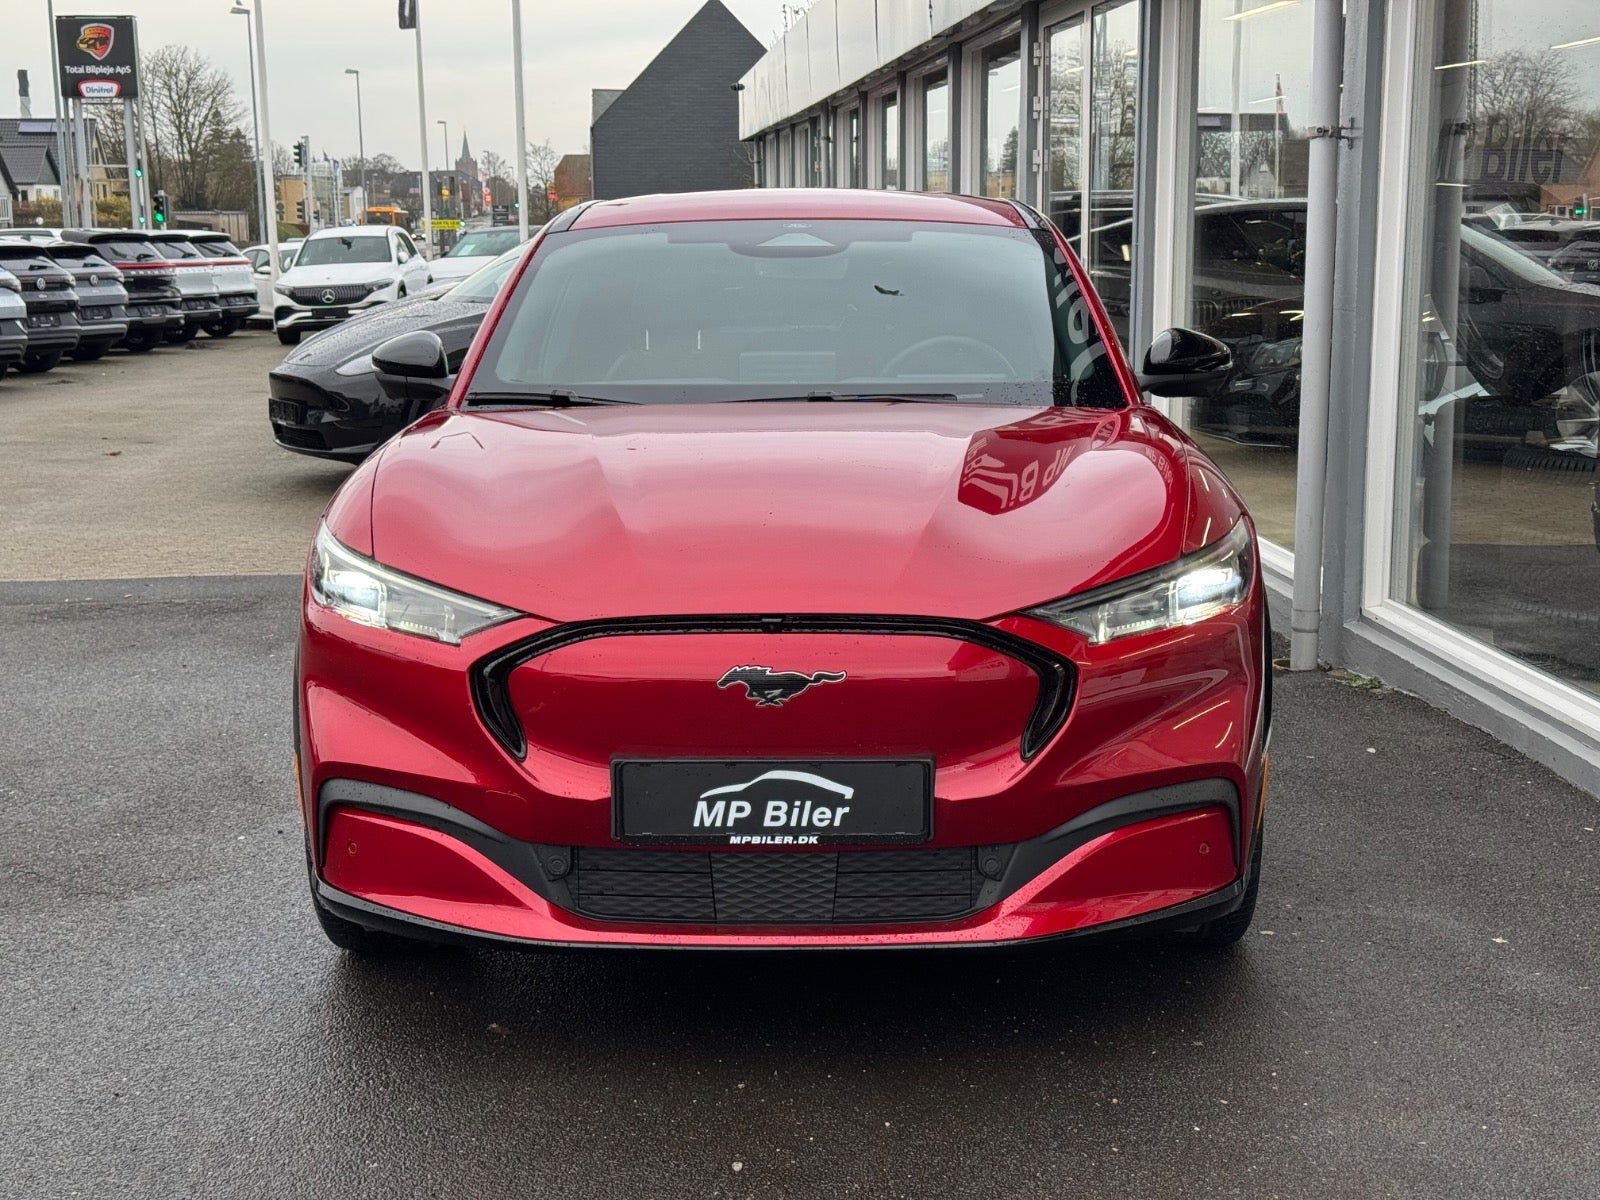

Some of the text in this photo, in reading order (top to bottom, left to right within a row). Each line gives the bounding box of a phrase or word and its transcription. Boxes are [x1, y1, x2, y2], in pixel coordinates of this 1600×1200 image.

[65, 65, 131, 75] Total Bilpleje ApS
[693, 800, 850, 828] MP Biler
[729, 836, 819, 845] MPBILER.DK
